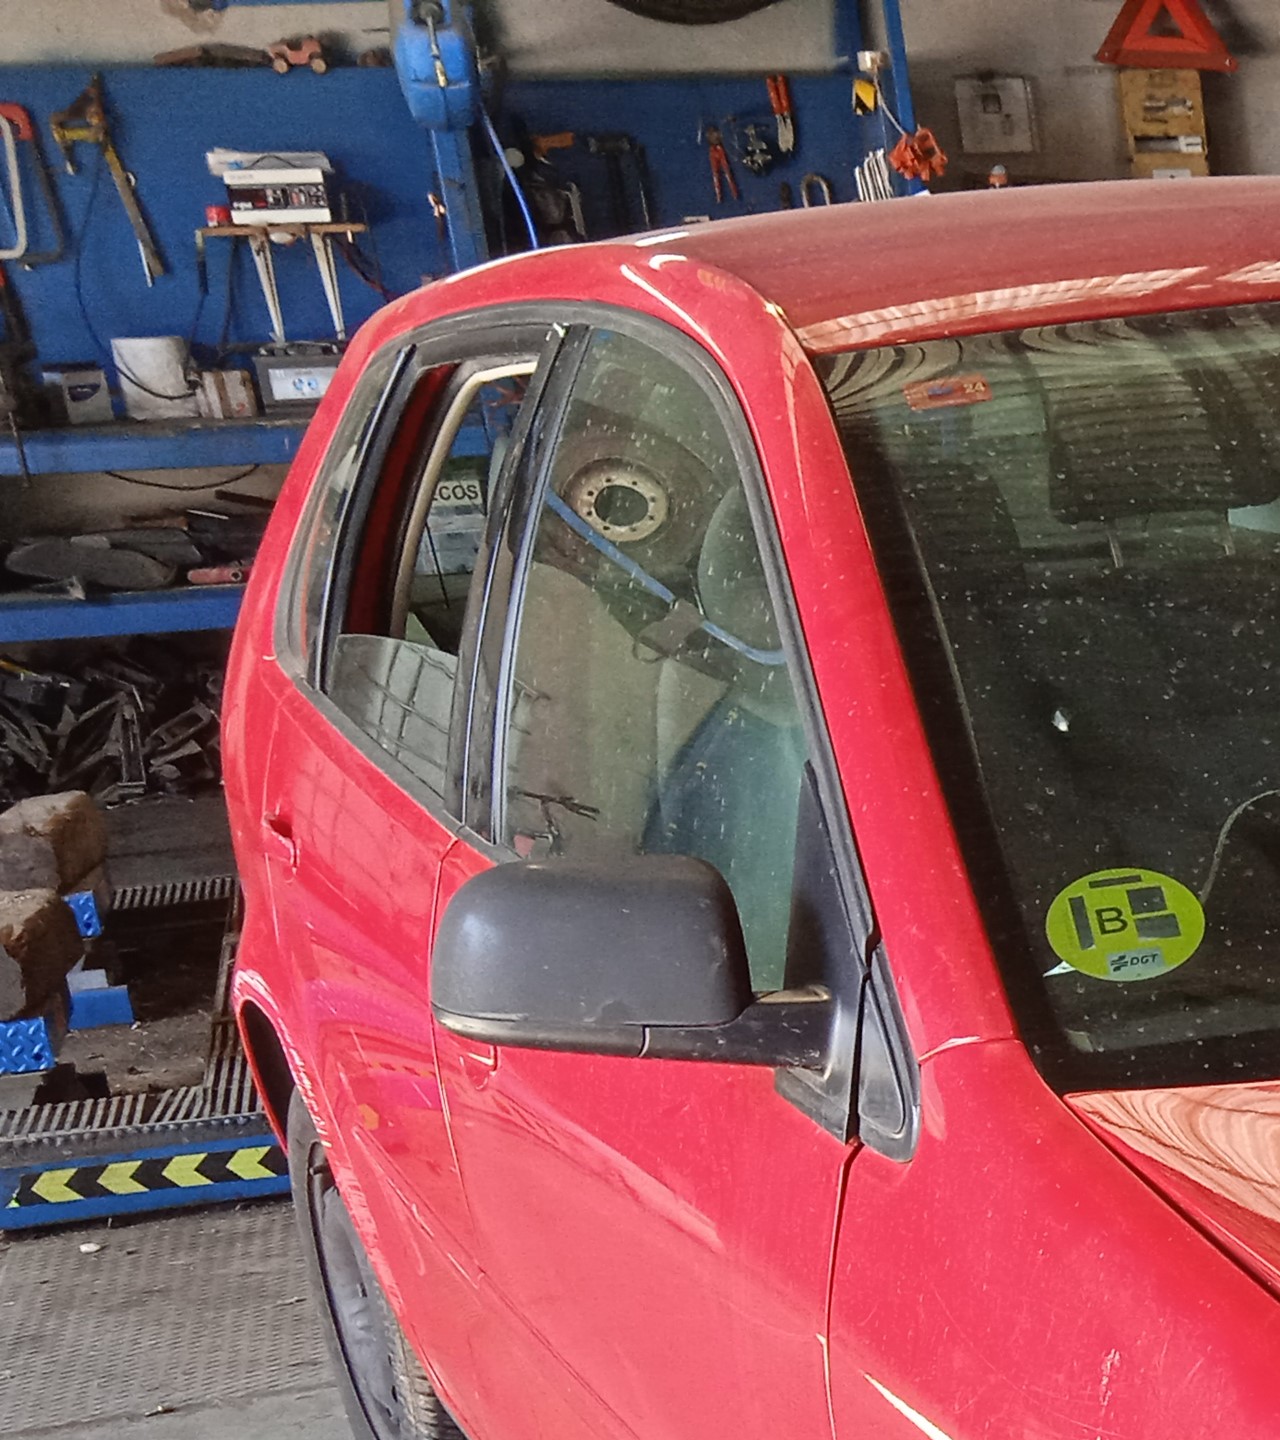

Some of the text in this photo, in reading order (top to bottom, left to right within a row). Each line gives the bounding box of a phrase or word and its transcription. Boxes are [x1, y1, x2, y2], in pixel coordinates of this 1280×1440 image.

[963, 382, 986, 394] 24
[432, 484, 479, 501] COS
[1095, 907, 1128, 935] B
[1130, 953, 1158, 966] DGT
